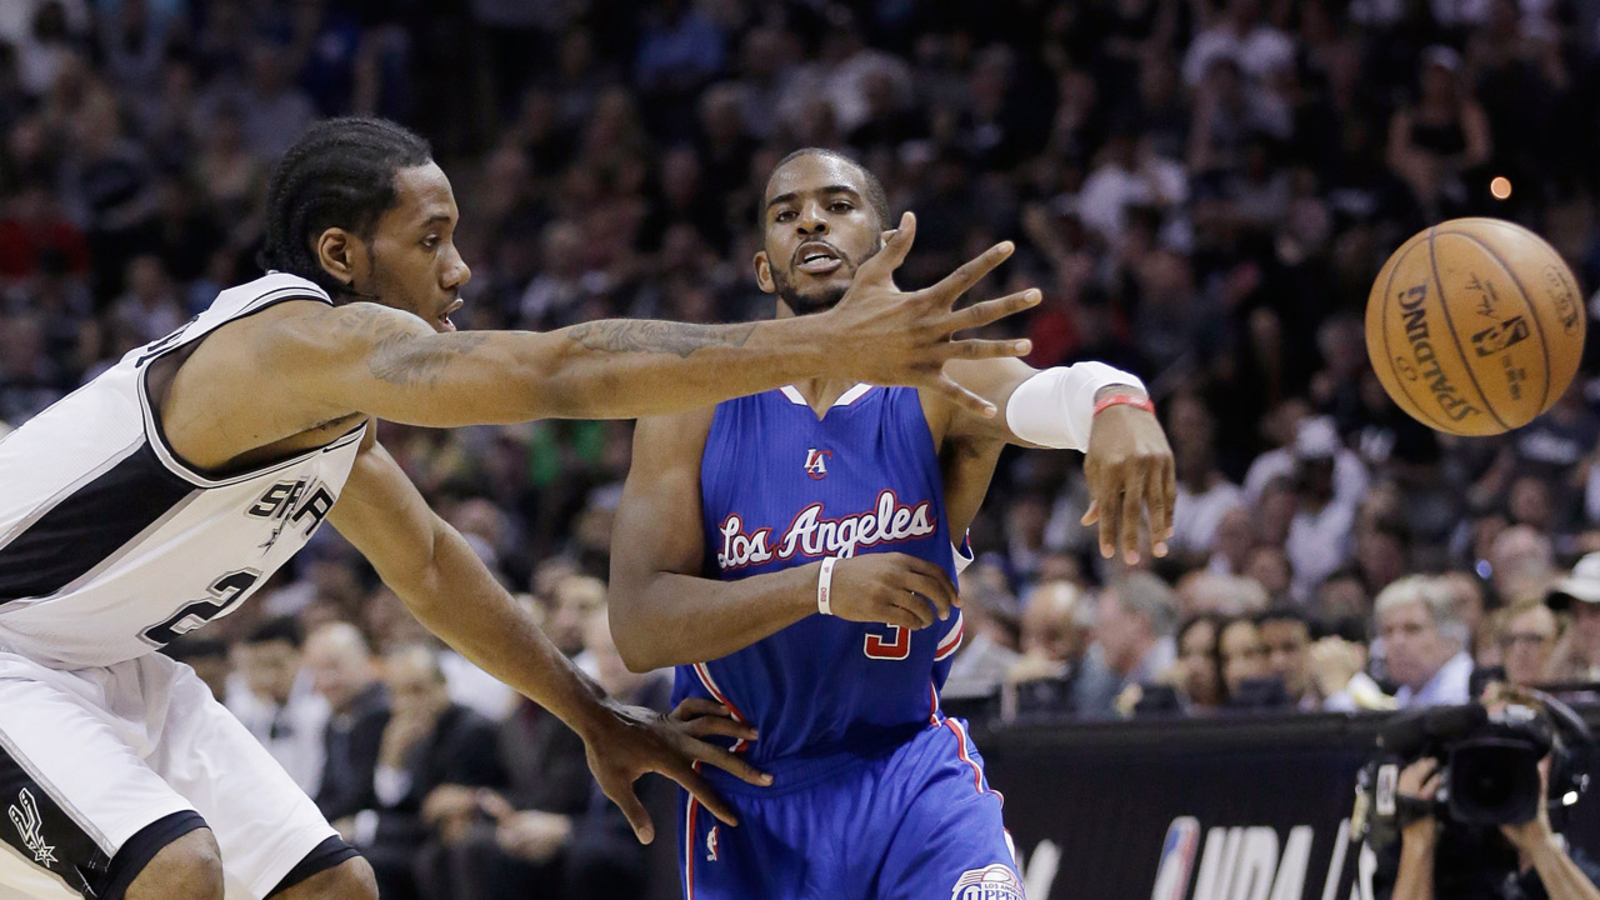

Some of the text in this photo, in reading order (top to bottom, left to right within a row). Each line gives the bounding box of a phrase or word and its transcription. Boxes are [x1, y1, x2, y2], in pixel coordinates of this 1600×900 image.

[1397, 284, 1481, 421] SPALDING
[717, 489, 937, 571] Los Angeles
[136, 567, 263, 646] 2
